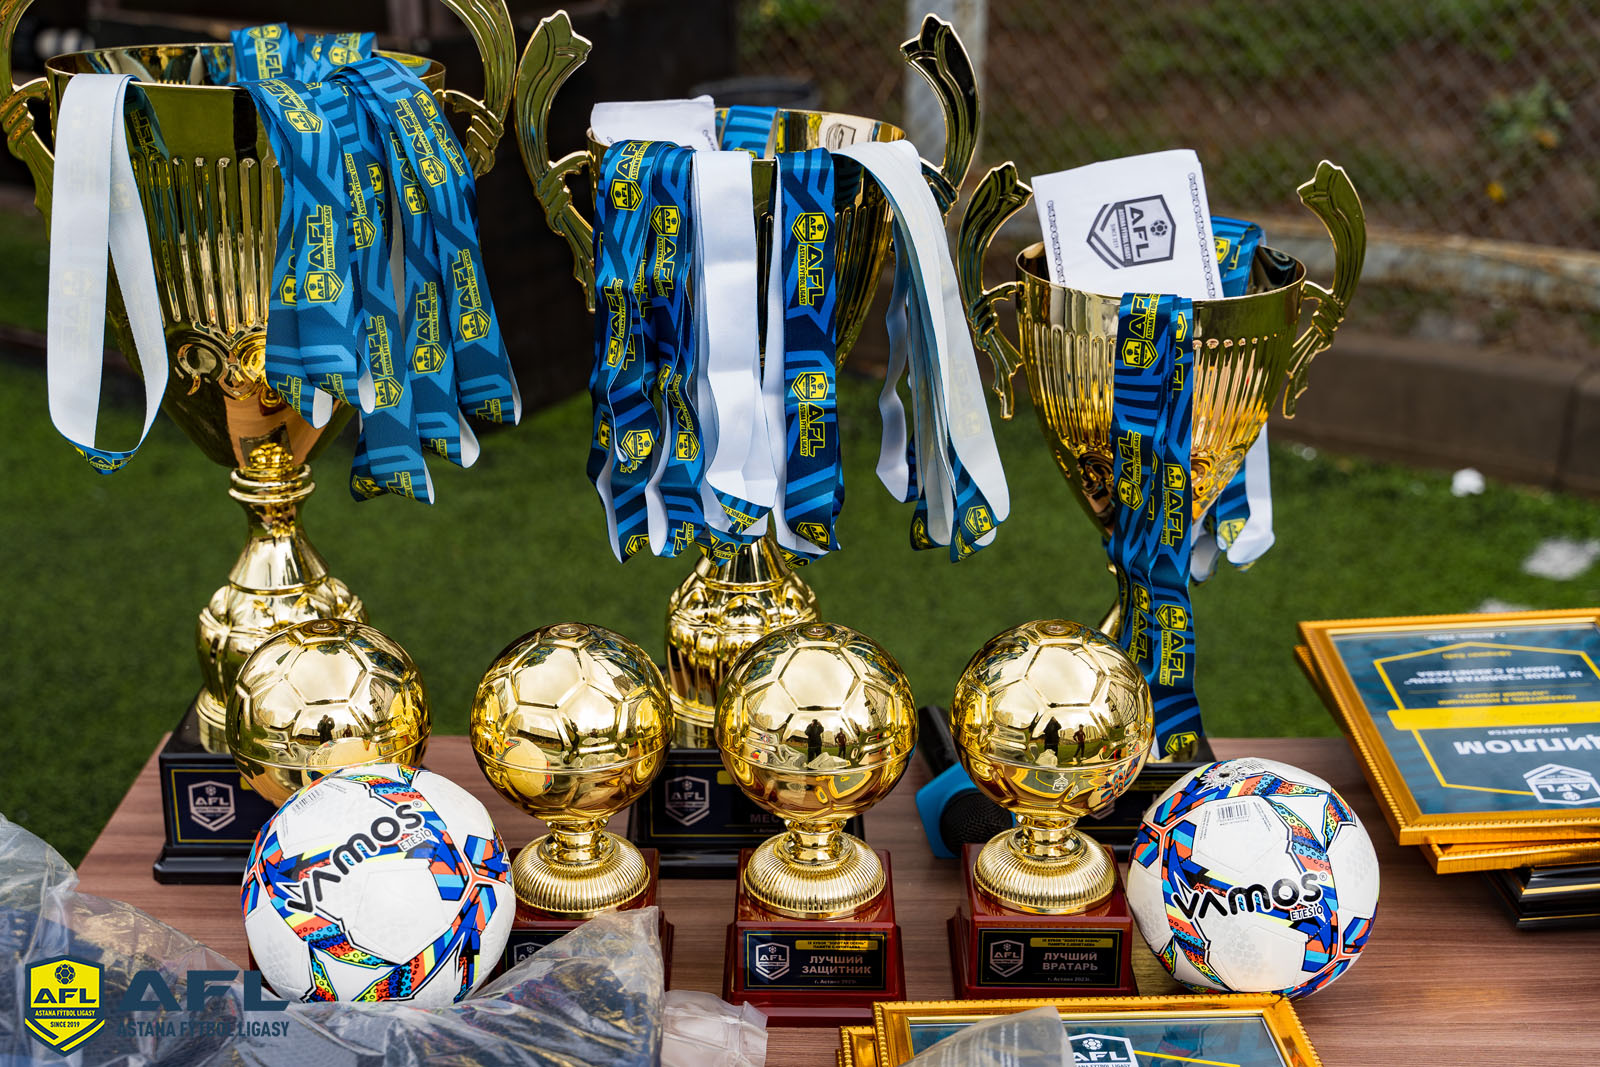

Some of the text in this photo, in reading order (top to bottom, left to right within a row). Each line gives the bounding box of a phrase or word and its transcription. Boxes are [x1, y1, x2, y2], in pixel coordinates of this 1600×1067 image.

[396, 99, 428, 155] AFL
[632, 158, 642, 178] ASTANA
[307, 205, 326, 270] AFL
[1130, 207, 1150, 258] AFL
[464, 250, 473, 268] LIGASY
[662, 237, 676, 297] AFL
[807, 244, 824, 306] AFL
[452, 251, 474, 309] AFL
[472, 286, 481, 306] ASTANA
[416, 282, 431, 342] AFL
[470, 314, 478, 336] AFL
[605, 278, 622, 337] AFL
[378, 317, 386, 335] LIGASY
[366, 316, 385, 376] AFL
[384, 353, 393, 374] ASTANA
[808, 402, 825, 458] AFL
[1118, 430, 1134, 482] AFL
[1168, 490, 1183, 546] AFL
[1135, 610, 1148, 664] AFL
[1168, 630, 1186, 686] AFL
[1488, 727, 1568, 736] НАГРАЖДАЕТСЯ
[195, 797, 229, 805] AFL
[671, 792, 704, 800] AFL
[1538, 783, 1590, 792] AFL
[400, 829, 432, 852] ETESIO
[287, 804, 422, 914] VAMOS
[1172, 873, 1322, 920] VAMOS
[1290, 906, 1323, 920] ETESIO
[802, 966, 871, 975] ЗАЩИТНИК
[809, 955, 864, 964] ЛУЧШИЙ
[1044, 952, 1097, 961] ЛУЧШИЙ
[1073, 1051, 1128, 1062] AFL
